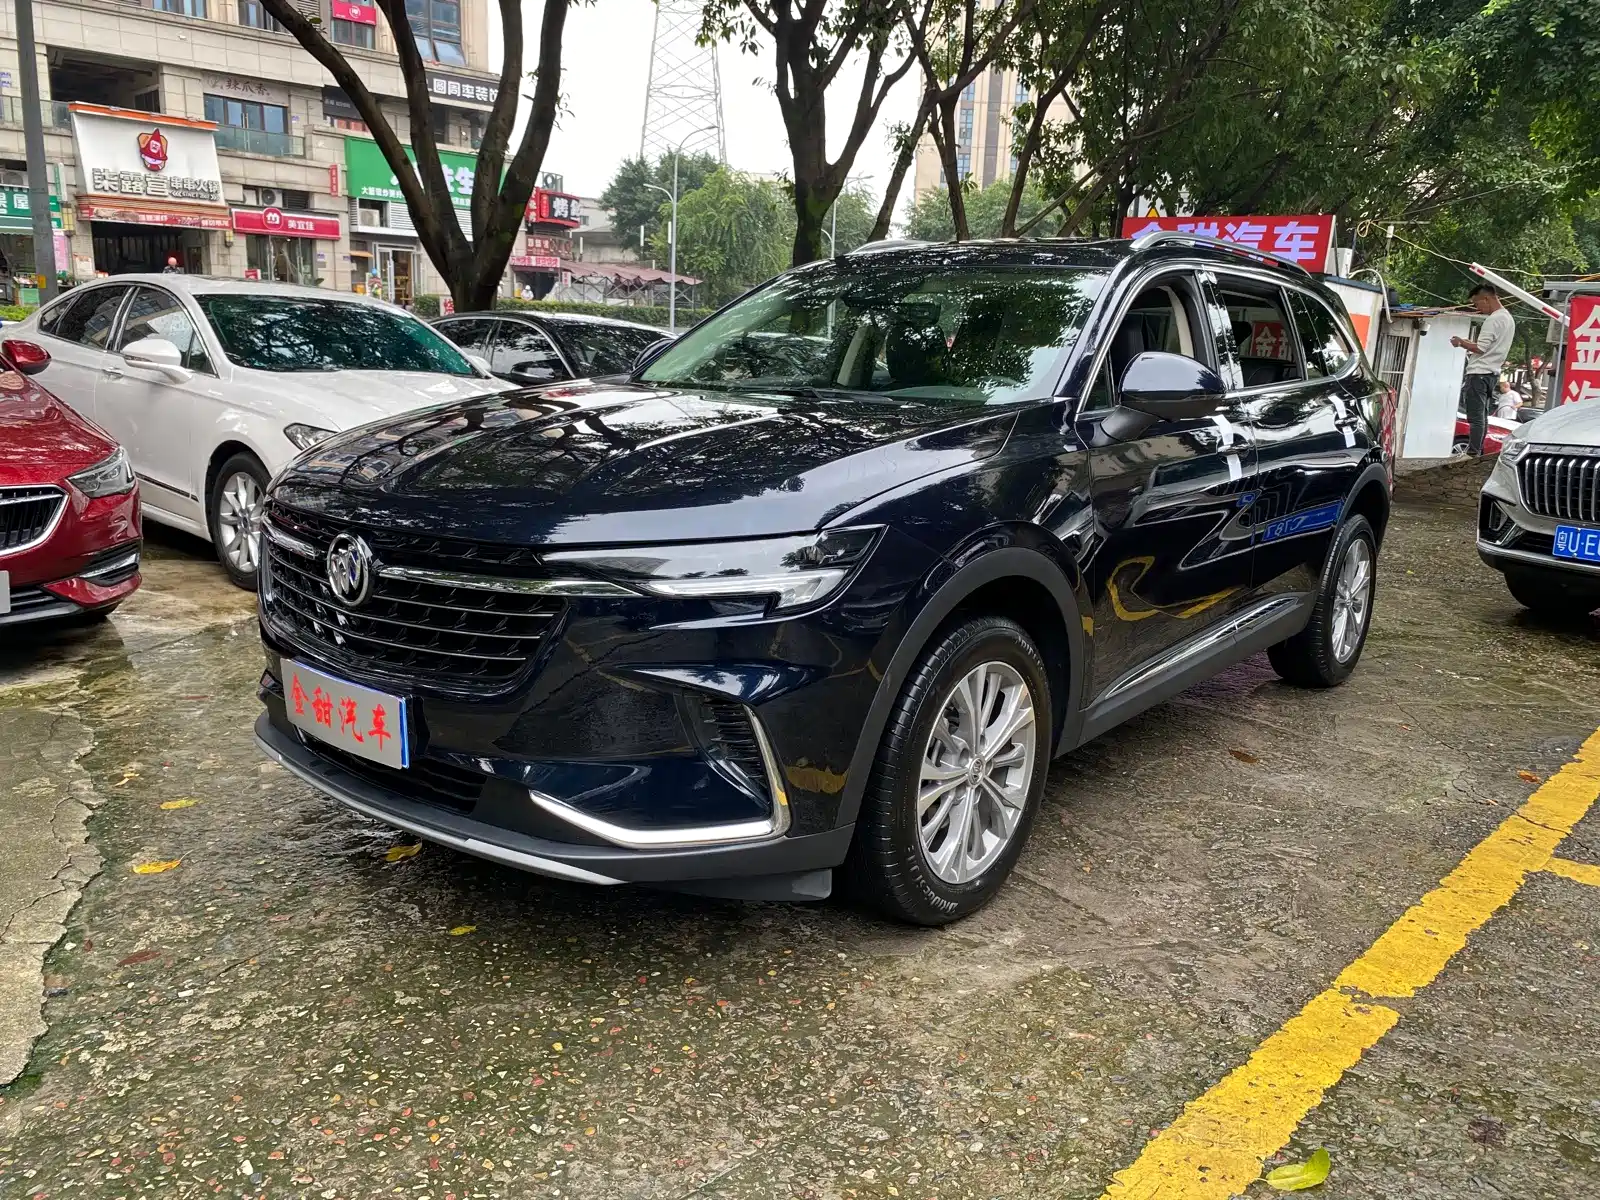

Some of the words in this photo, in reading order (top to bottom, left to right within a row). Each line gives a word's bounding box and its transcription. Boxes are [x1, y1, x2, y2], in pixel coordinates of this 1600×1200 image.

[169, 175, 220, 193] 串串火锅
[288, 219, 315, 231] 美宜佳
[1131, 221, 1319, 263] 汽车
[1557, 531, 1600, 556] 粤U·E
